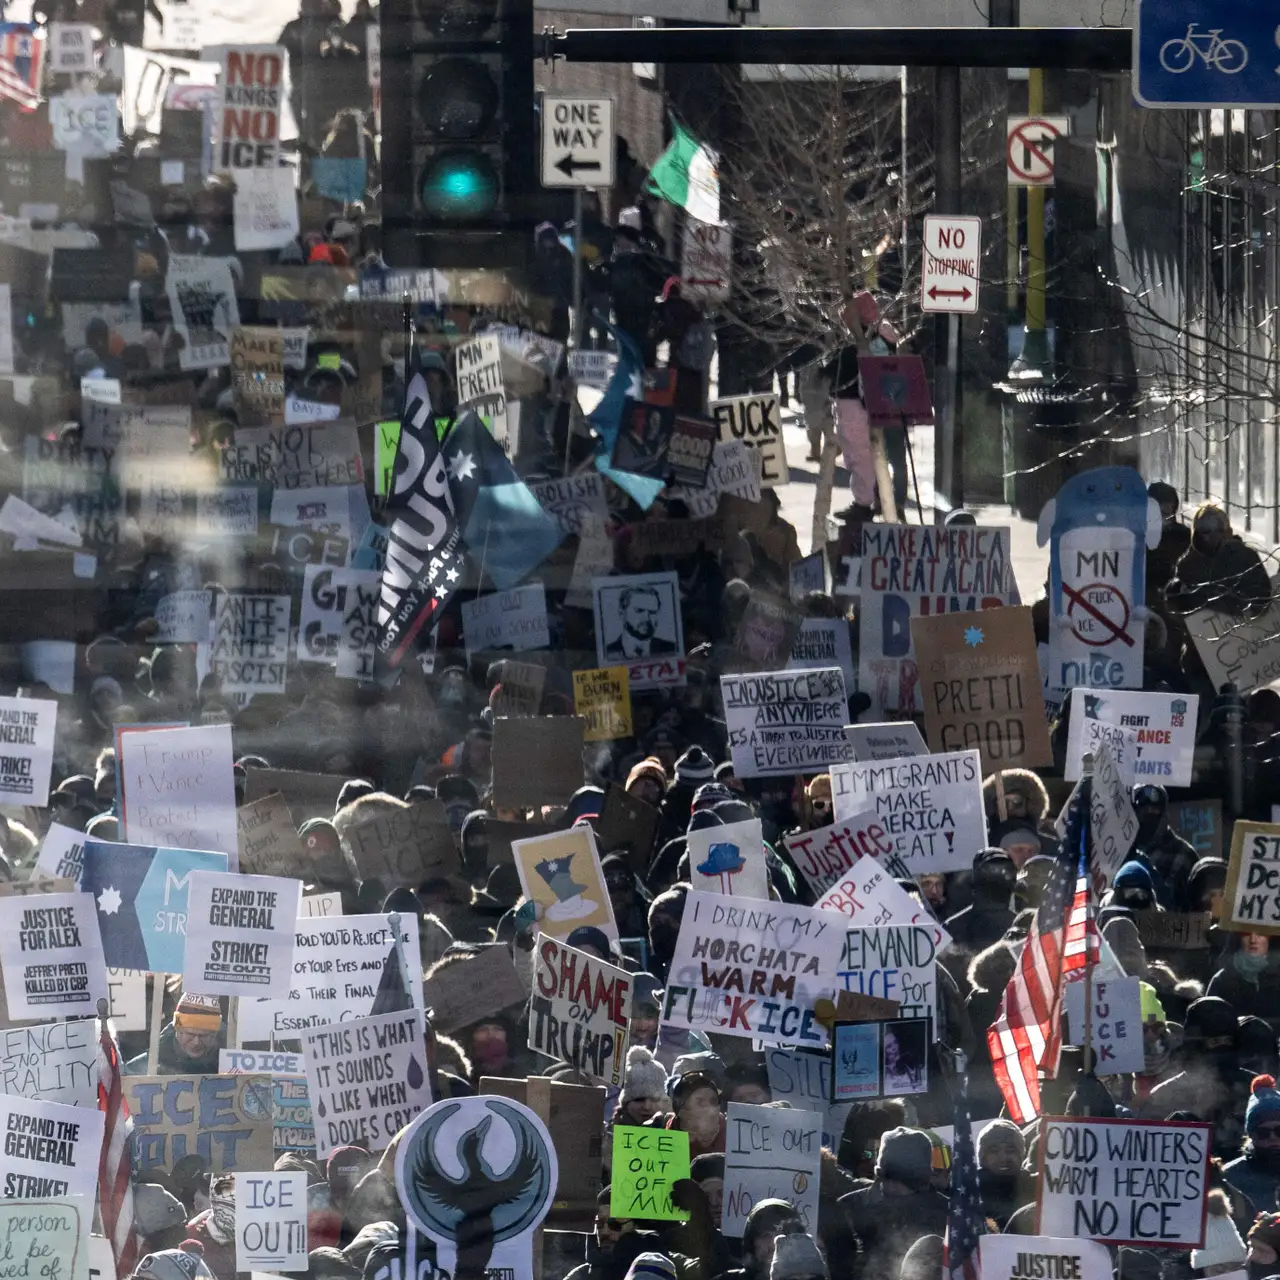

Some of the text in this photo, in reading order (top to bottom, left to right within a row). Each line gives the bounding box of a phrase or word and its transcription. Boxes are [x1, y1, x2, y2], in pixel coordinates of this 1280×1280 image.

[228, 50, 280, 85] NO
[224, 108, 276, 139] NO
[555, 103, 600, 124] ONE
[553, 128, 601, 149] WAY
[938, 228, 965, 249] NO
[928, 257, 974, 277] STOPPING
[714, 399, 778, 439] FUCK
[863, 529, 1004, 559] MAKE AMERICA
[871, 556, 939, 593] GREAT
[1077, 551, 1120, 577] MN
[934, 672, 1024, 714] PRETTI
[941, 718, 1027, 759] GOOD
[835, 756, 976, 795] IMMIGRANTS
[876, 790, 932, 812] MAKE
[20, 906, 76, 930] JUSTICE
[694, 902, 827, 938] I DRINK MY
[20, 927, 81, 951] FOR ALEX
[692, 935, 820, 976] HORCHATA
[538, 942, 628, 1027] SHAME
[701, 962, 796, 1000] WARM
[568, 1000, 592, 1021] ON
[663, 985, 821, 1039] FUCK ICE
[530, 1000, 625, 1084] TRUMP!
[132, 1075, 239, 1126] ICE
[333, 1081, 406, 1113] LIKE WHEN
[328, 1118, 379, 1145] DOVES
[623, 1132, 673, 1153] ICE
[730, 1118, 815, 1154] ICE OUT
[1046, 1127, 1202, 1164] COLD WINTERS
[629, 1159, 670, 1175] OUT
[1045, 1164, 1200, 1198] WARM HEARTS
[246, 1180, 292, 1208] ICE
[634, 1176, 667, 1191] OF
[629, 1194, 673, 1213] MN
[1074, 1200, 1183, 1238] NO ICE
[1011, 1252, 1081, 1279] JUSTICE
